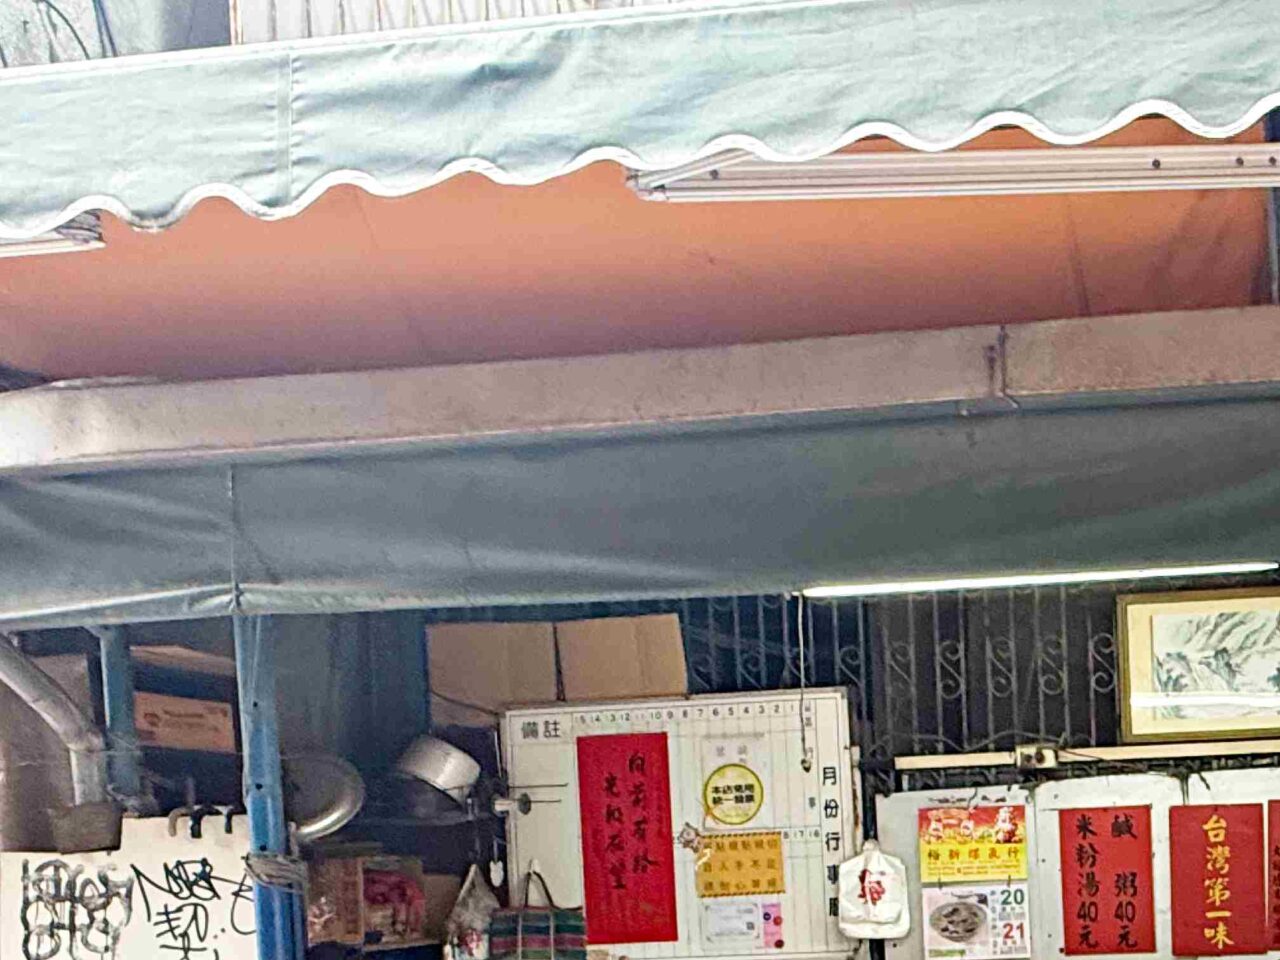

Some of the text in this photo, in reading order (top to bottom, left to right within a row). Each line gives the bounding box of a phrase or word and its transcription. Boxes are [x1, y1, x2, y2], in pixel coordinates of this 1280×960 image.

[621, 712, 630, 721] 12
[651, 711, 662, 720] 10
[712, 707, 719, 716] 6
[728, 707, 734, 716] 5
[744, 705, 750, 714] 4
[759, 705, 765, 714] 3
[774, 704, 780, 713] 2
[1075, 813, 1100, 948] 米粉湯40元
[1202, 814, 1235, 950] 台灣第一味
[1000, 888, 1025, 906] 20
[1002, 922, 1025, 940] 21
